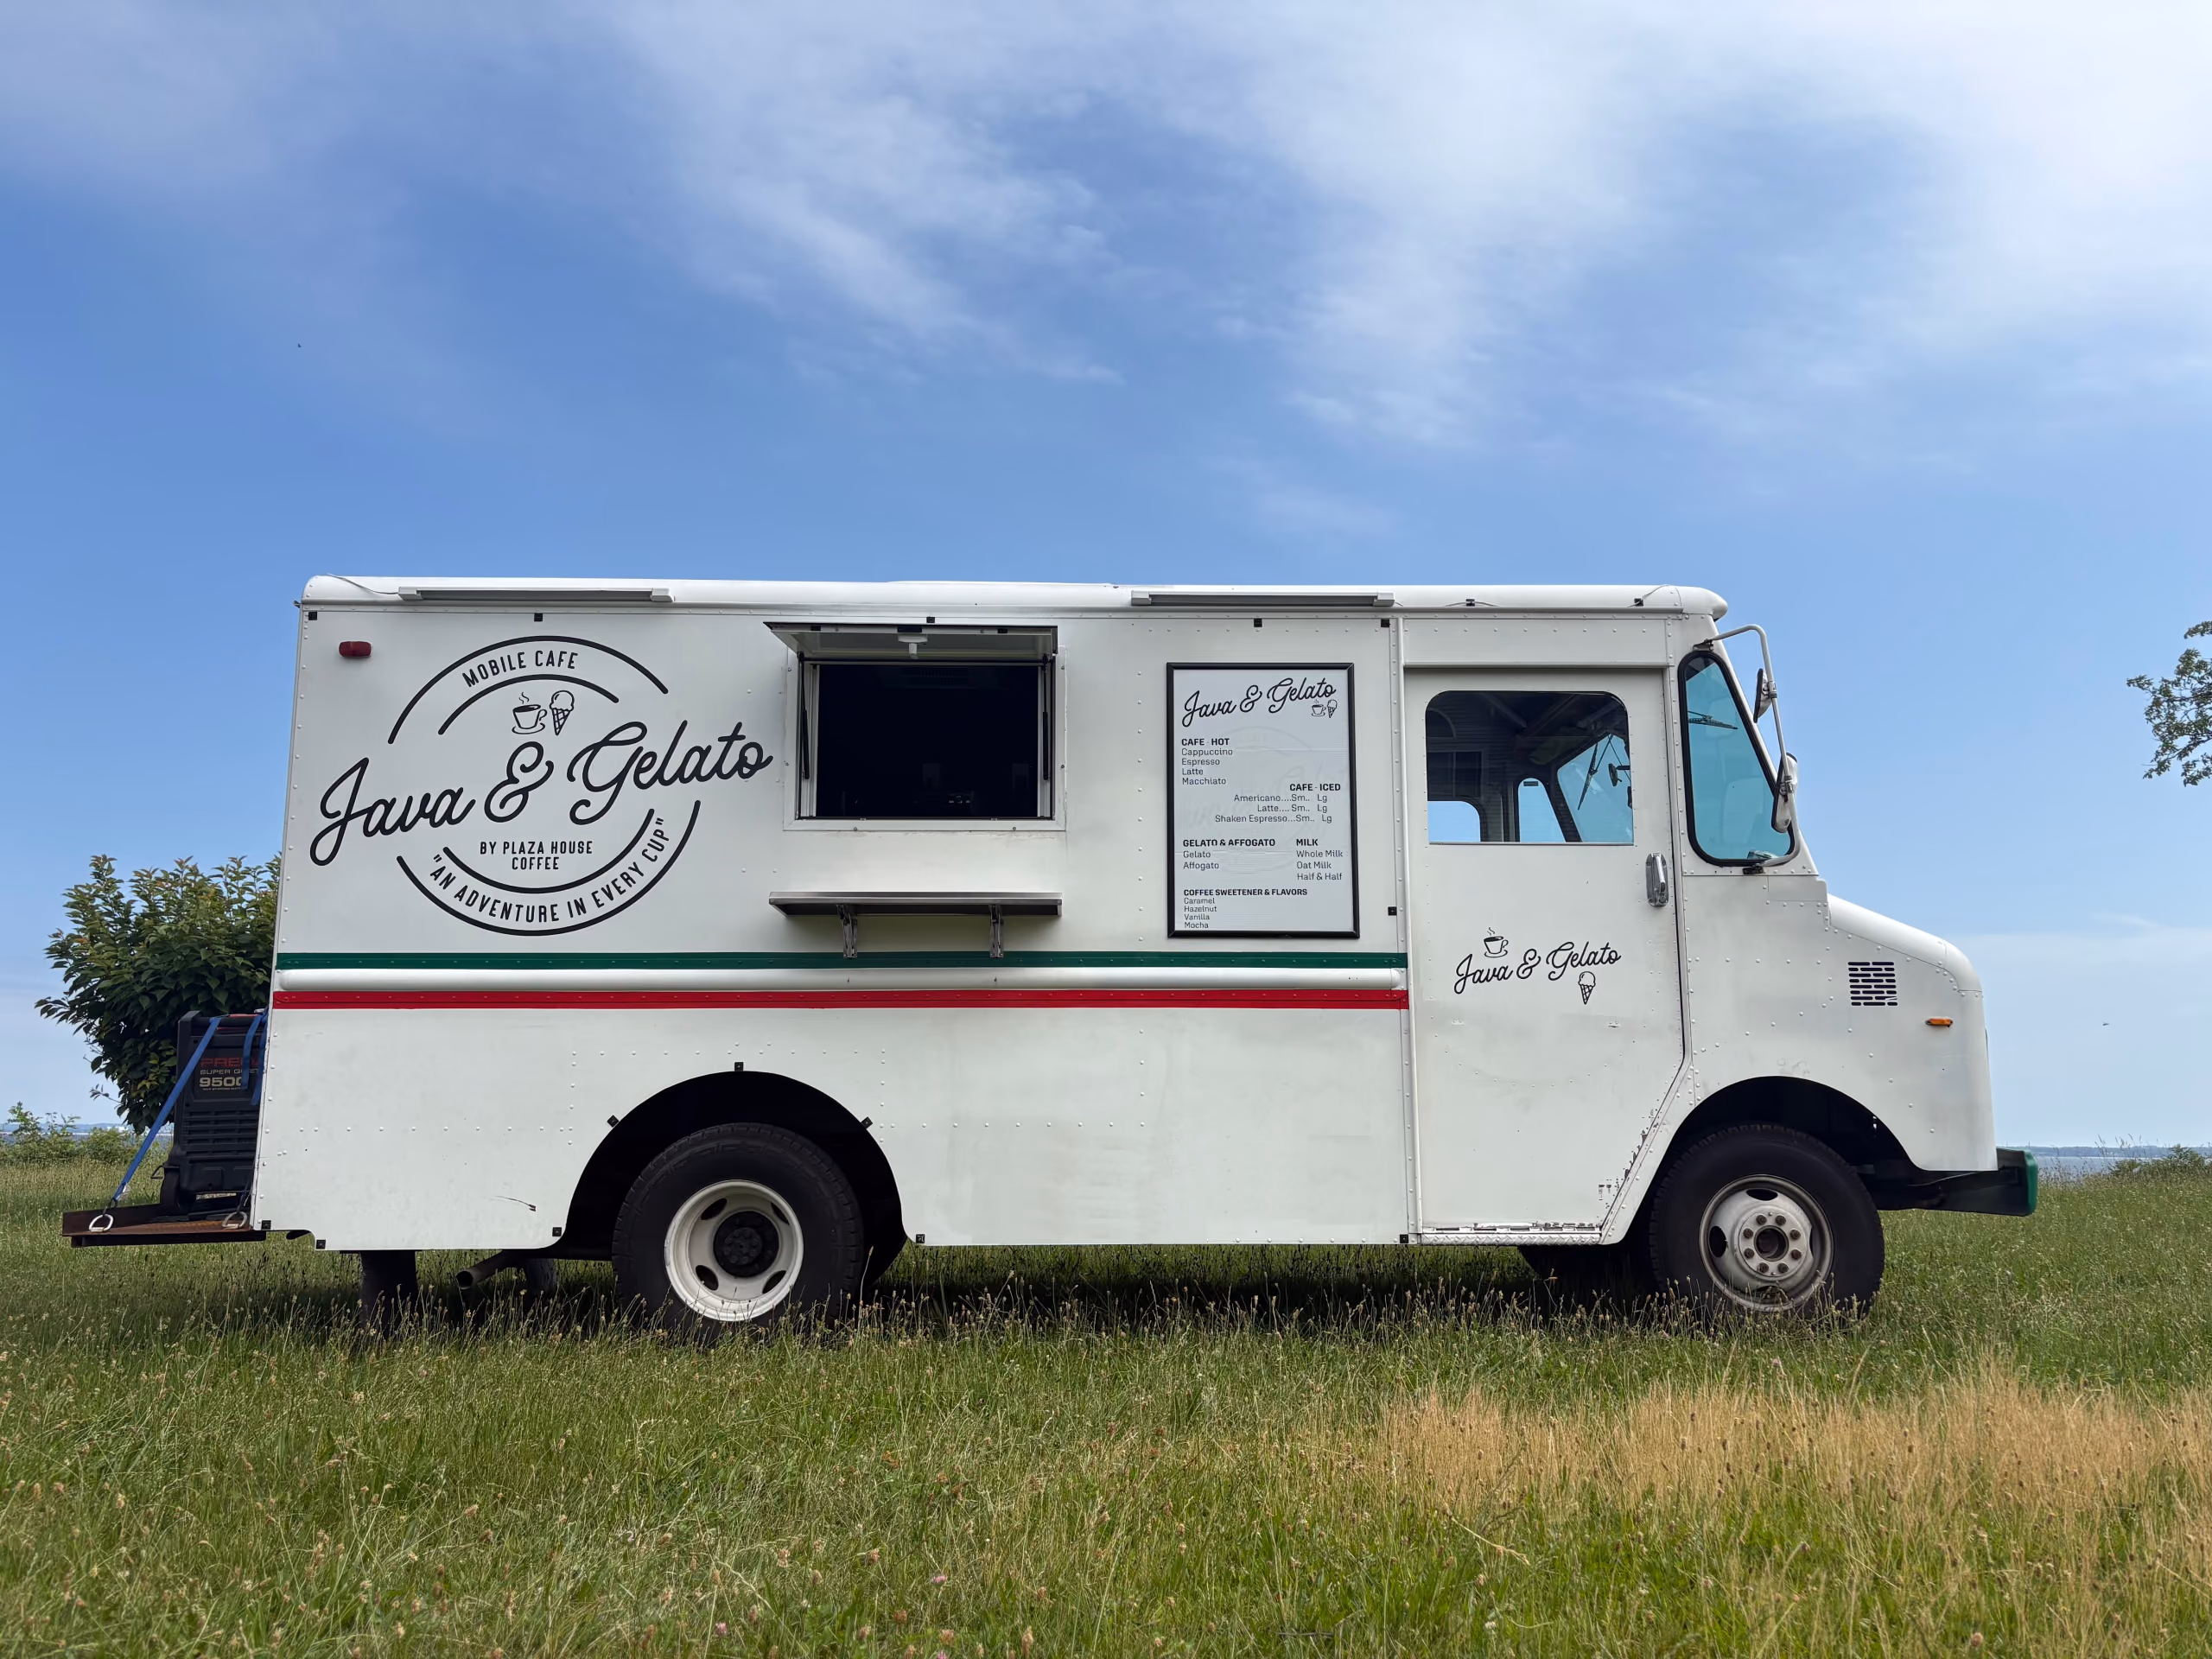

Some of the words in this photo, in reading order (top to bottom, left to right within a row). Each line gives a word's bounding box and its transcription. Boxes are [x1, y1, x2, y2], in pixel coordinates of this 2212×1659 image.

[462, 652, 526, 687] MOBILE
[535, 650, 578, 670] CAFE
[1181, 690, 1237, 728] Java
[1239, 684, 1262, 713] &
[1266, 677, 1337, 714] Gelato
[1181, 738, 1205, 747] CAFE
[1211, 737, 1230, 746] HOT
[1181, 747, 1233, 757] Cappuccino
[1181, 758, 1220, 767] Espresso
[1182, 767, 1204, 776] Latte
[1182, 777, 1227, 785] Macchiato
[1289, 783, 1313, 791] CAFE
[1319, 783, 1341, 791] ICED
[309, 758, 476, 867] Java
[484, 741, 554, 823] &
[567, 719, 773, 825] Gelato
[1317, 793, 1328, 804] Lg
[1317, 804, 1328, 813] Lg
[1215, 814, 1247, 823] Shaken
[1321, 814, 1332, 824] Lg
[480, 841, 497, 855] BY
[503, 841, 544, 855] PLAZA
[550, 840, 593, 855] HOUSE
[1183, 839, 1218, 848] GELATO
[1228, 838, 1275, 847] AFFOGATO
[1295, 838, 1319, 847] MILK
[1183, 850, 1211, 859] Gelato
[1296, 849, 1324, 858] Whole
[1325, 849, 1344, 858] Milk
[512, 856, 560, 870] COFFEE
[1183, 861, 1220, 871] Affogato
[1296, 861, 1312, 869] Oat
[1313, 861, 1332, 869] Milk
[1297, 872, 1315, 880] Half
[1316, 872, 1324, 880] &
[1325, 872, 1343, 880] Half
[454, 885, 560, 923] ADVENTURE
[567, 897, 587, 918] IN
[591, 861, 645, 908] EVERY
[1453, 953, 1514, 995] Java
[1516, 948, 1541, 980] &
[1545, 941, 1622, 982] Gelato
